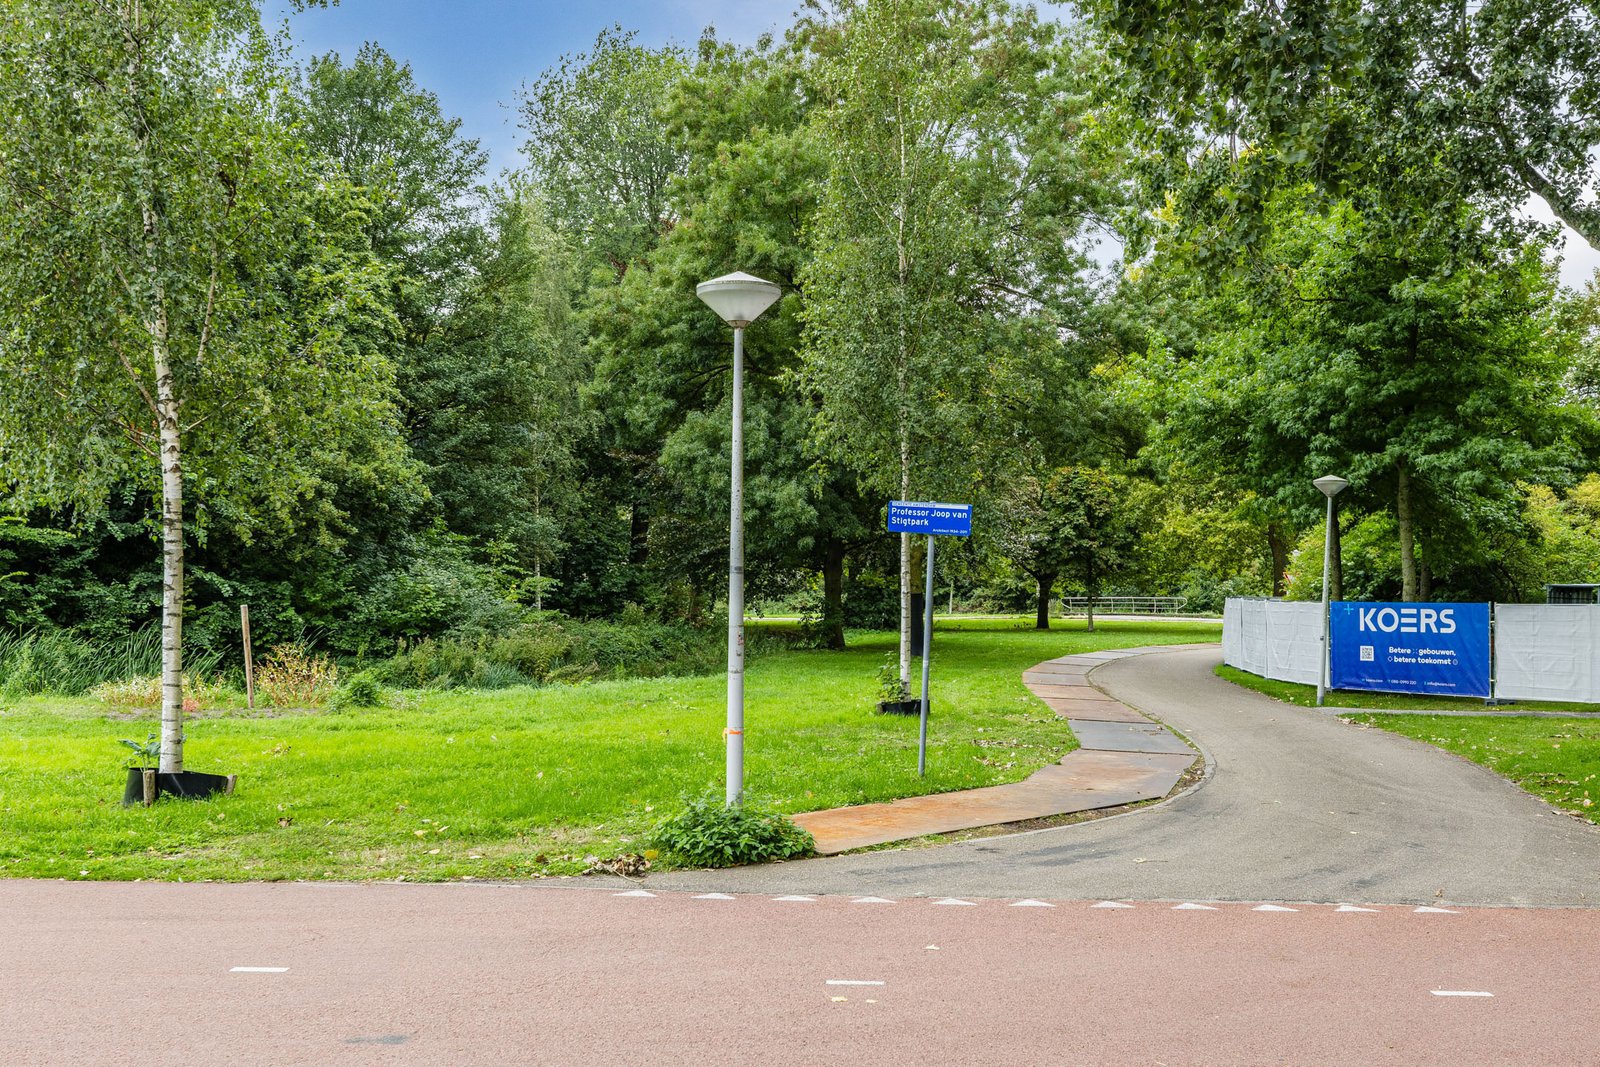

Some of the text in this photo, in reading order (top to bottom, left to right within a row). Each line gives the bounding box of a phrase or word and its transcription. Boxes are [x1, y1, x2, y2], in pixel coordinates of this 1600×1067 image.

[892, 508, 930, 516] Professor
[931, 510, 950, 518] Joop
[892, 517, 929, 526] Stigtpark
[1359, 607, 1457, 634] KOERS
[1388, 646, 1457, 656] Betere gebouwen,
[1393, 656, 1452, 665] betere toekomst
